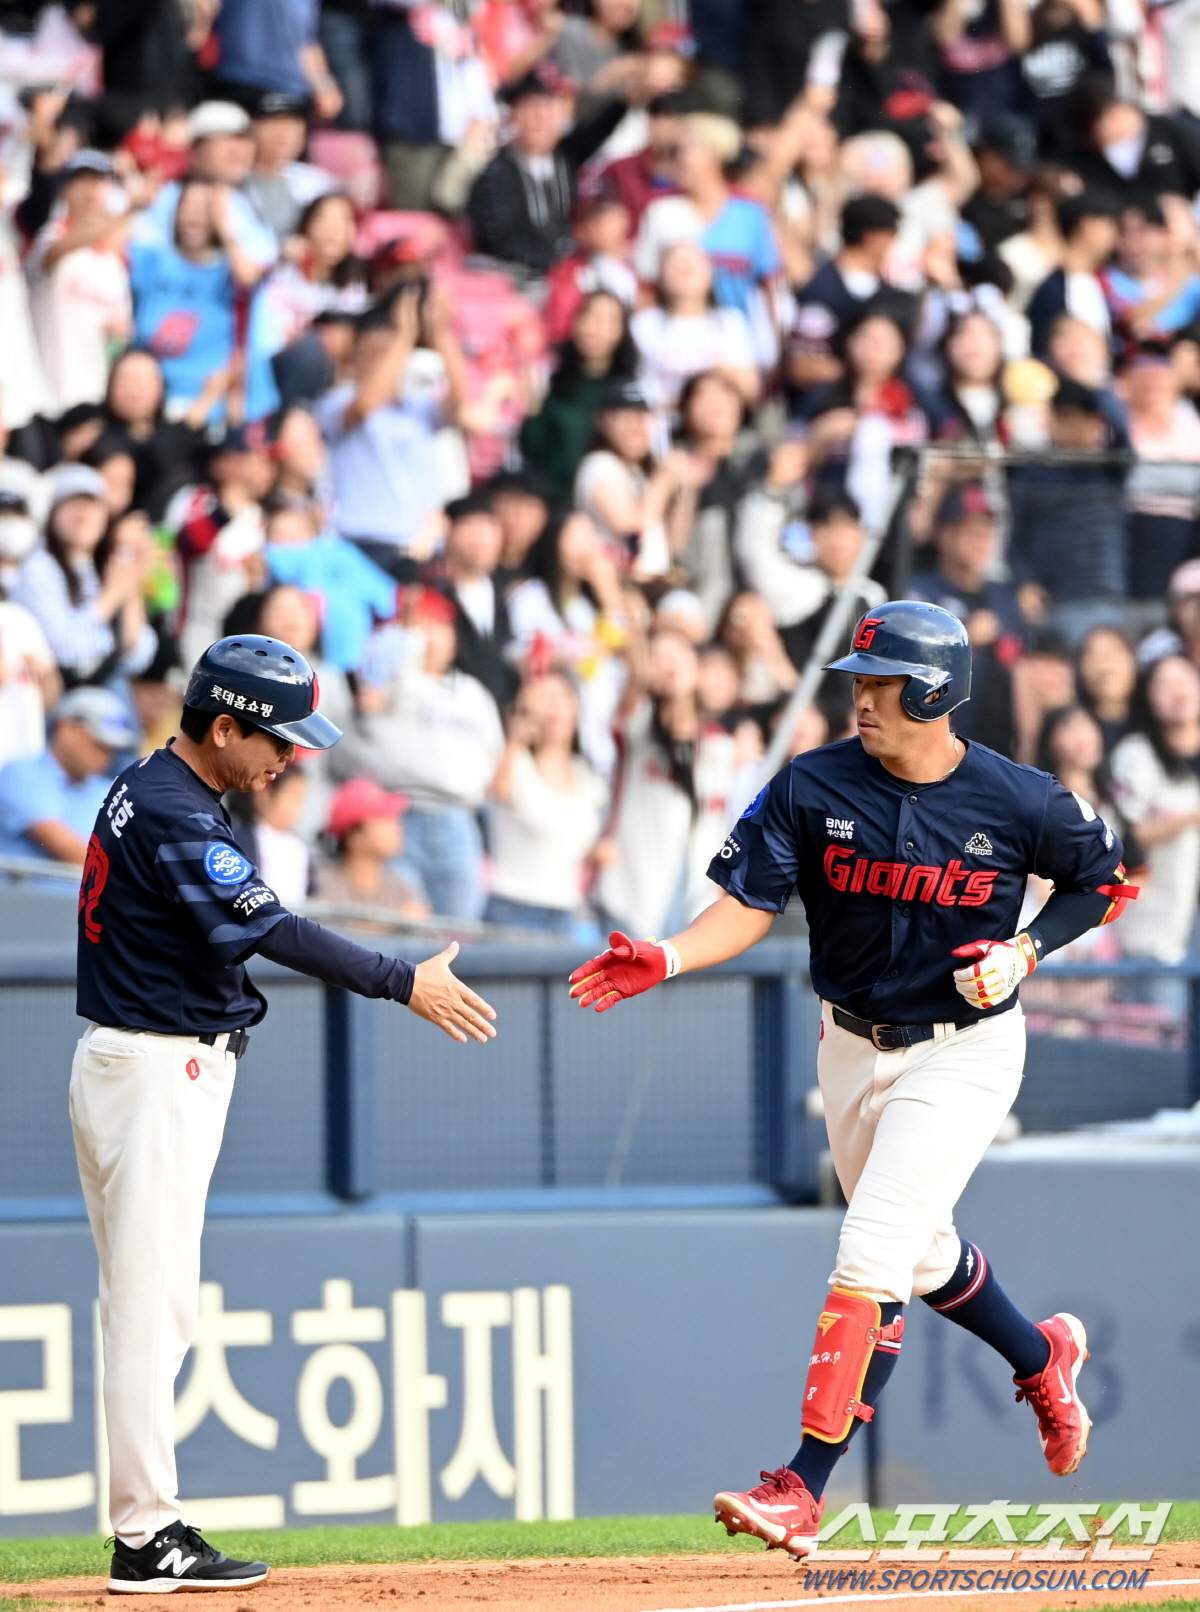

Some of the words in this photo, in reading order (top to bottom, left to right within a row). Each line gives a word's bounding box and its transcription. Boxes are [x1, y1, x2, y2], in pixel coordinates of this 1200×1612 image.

[854, 618, 883, 650] G
[210, 684, 274, 718] 롯데홈쇼핑
[825, 817, 855, 831] BNK
[826, 829, 853, 840] 부산은행
[964, 845, 993, 856] Kappa
[240, 891, 275, 916] ZERO
[806, 1386, 818, 1401] 8
